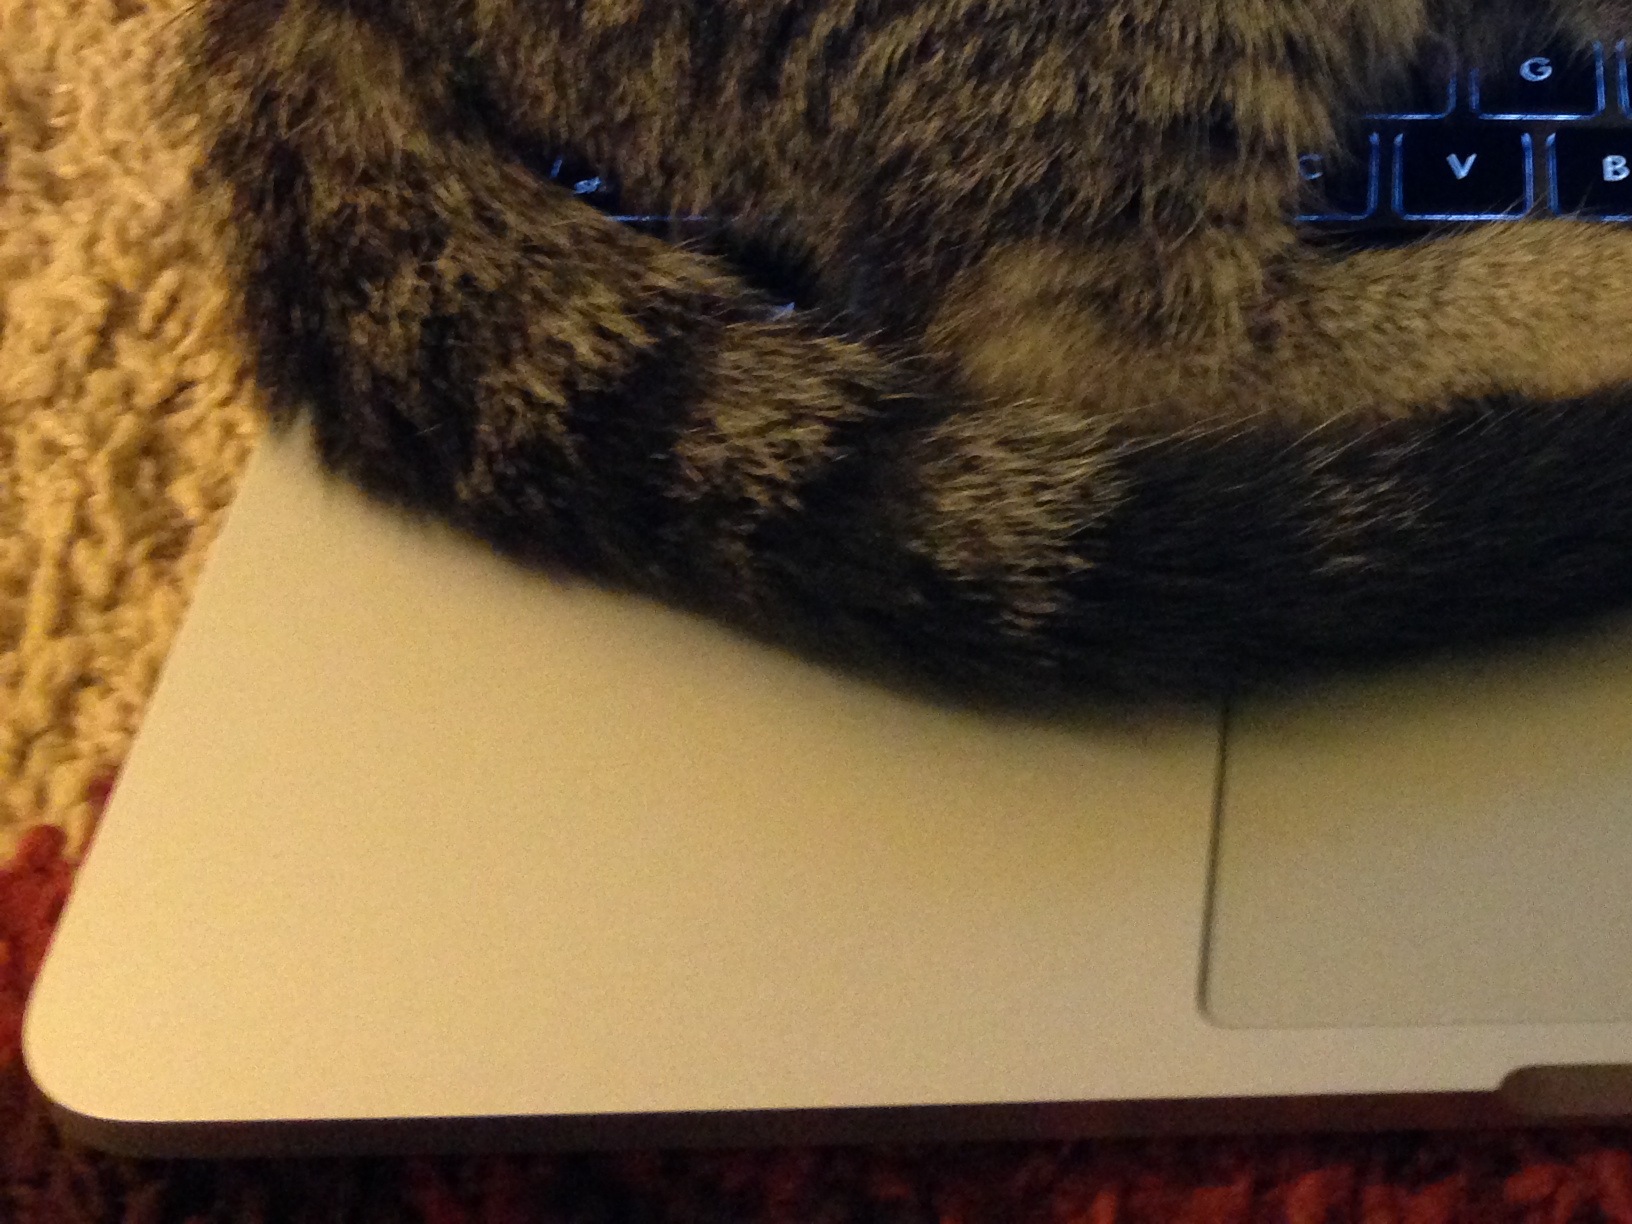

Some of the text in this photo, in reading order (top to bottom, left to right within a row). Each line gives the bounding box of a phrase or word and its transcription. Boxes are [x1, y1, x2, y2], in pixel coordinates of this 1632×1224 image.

[1520, 57, 1552, 81] G
[1447, 154, 1477, 179] V
[1603, 155, 1630, 181] B
